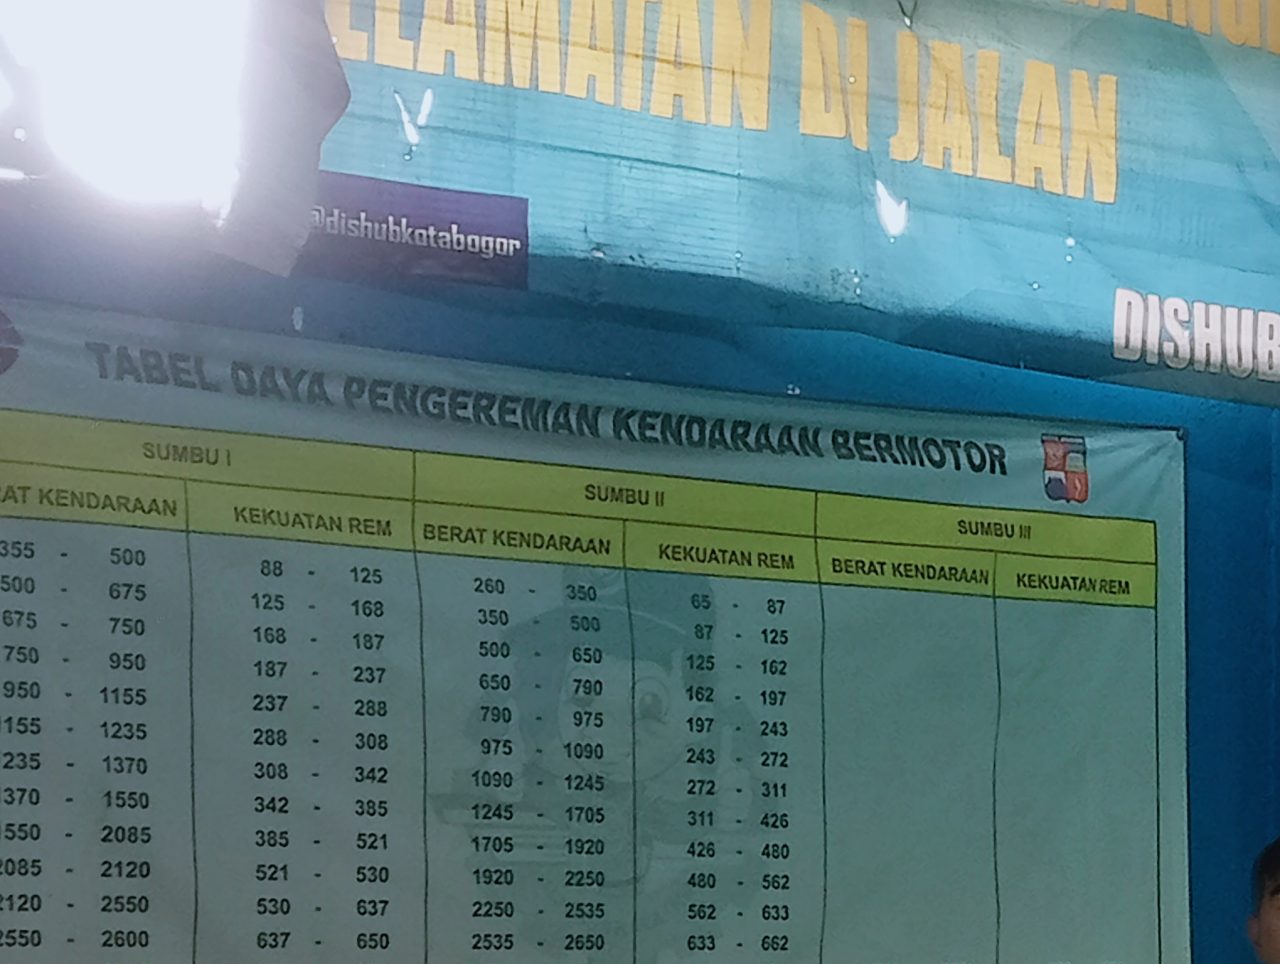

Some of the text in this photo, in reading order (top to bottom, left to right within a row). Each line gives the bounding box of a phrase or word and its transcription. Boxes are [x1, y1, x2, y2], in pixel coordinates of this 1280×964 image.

[800, 5, 868, 151] DI
[889, 33, 1118, 204] JALAN
[85, 341, 1008, 476] TABEL DAYA PENGEREMAN KENDARAAN BERMOTOR
[142, 442, 219, 466] SUMBU
[38, 488, 177, 517] KENDARAAN
[585, 484, 649, 506] SUMBU
[234, 506, 392, 537] KEKUATAN REM
[957, 520, 1014, 539] SUMBU
[423, 523, 611, 556] BERAT KENDARAAN
[109, 547, 147, 567] 500
[658, 543, 794, 570] KEKUATAN REM
[260, 559, 384, 585] 88 125
[832, 558, 989, 585] BERAT KENDARAAN
[473, 576, 598, 602] 260 350
[1016, 573, 1130, 595] KEKUATAN REM
[690, 592, 786, 616] 65 87
[1, 609, 146, 637] 675 750
[252, 625, 385, 651] 168 187
[478, 640, 603, 664] 500 650
[685, 653, 788, 676] 125 162
[2, 680, 148, 707] 950 1155
[251, 693, 389, 718] 237 288
[479, 705, 604, 729] 790 975
[685, 716, 789, 738] 197 243
[101, 754, 149, 776] 1370
[253, 761, 389, 785] 308 342
[471, 769, 605, 792] 1090 1245
[686, 778, 787, 798] 272 311
[100, 824, 152, 845] 2085
[255, 829, 388, 851] 385 521
[470, 835, 605, 856] 1705 1920
[686, 840, 791, 860] 426 480
[100, 894, 150, 914] 2550
[256, 897, 390, 917] 530 637
[471, 900, 606, 920] 2250 2535
[687, 903, 790, 922] 562 633
